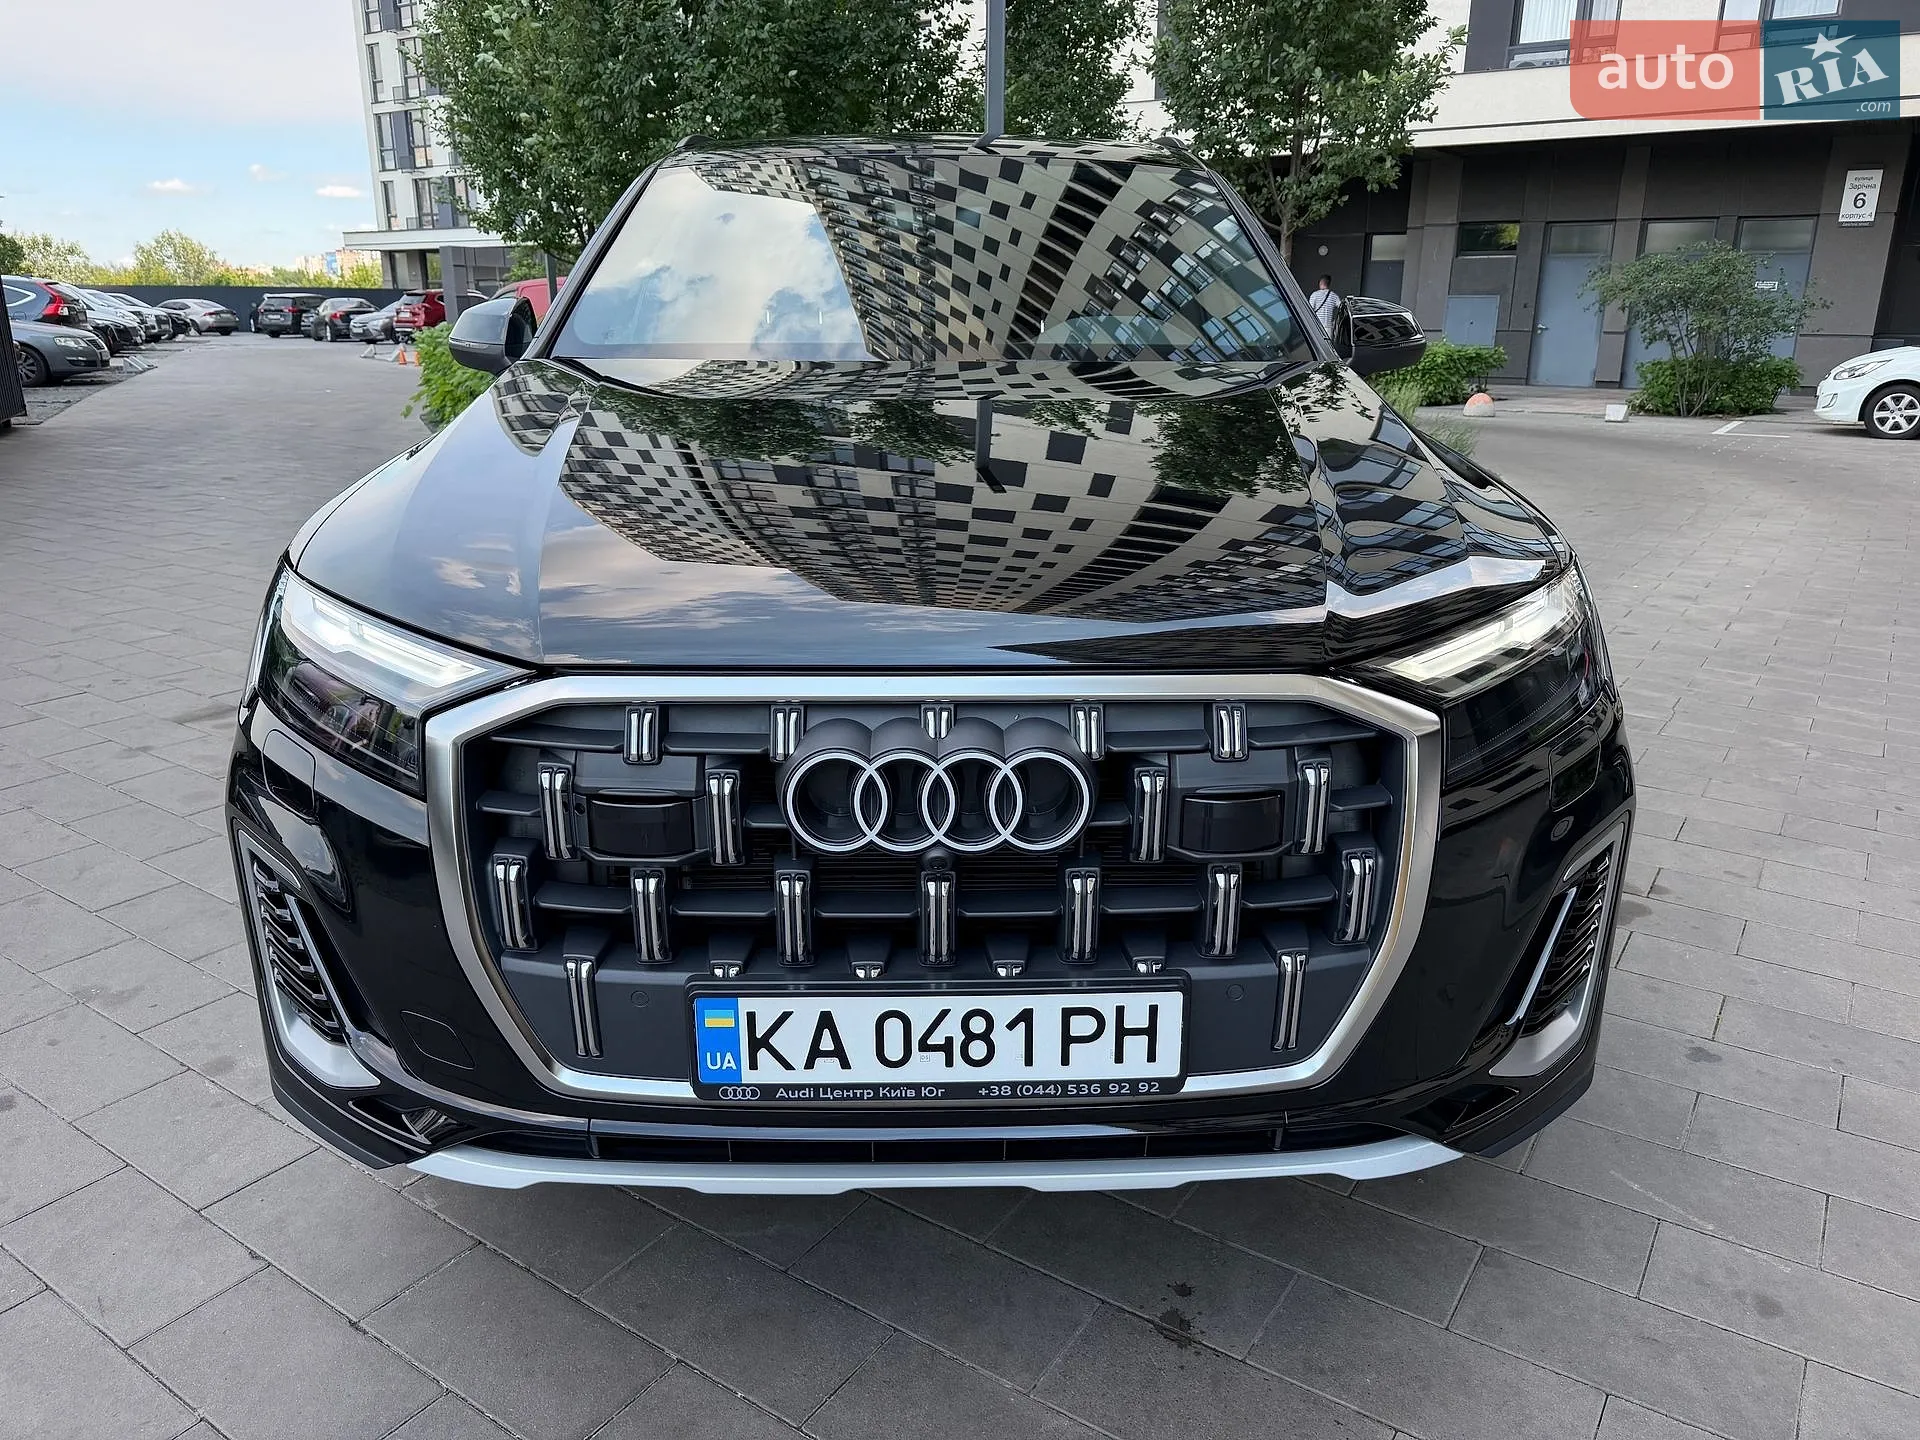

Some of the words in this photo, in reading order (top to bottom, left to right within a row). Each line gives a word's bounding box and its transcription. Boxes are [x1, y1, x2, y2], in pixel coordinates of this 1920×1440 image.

[1848, 182, 1877, 190] Зарічна
[1853, 192, 1867, 209] 6
[746, 1010, 852, 1071] KA
[874, 1008, 1034, 1069] 0481
[706, 1052, 737, 1070] UA
[776, 1087, 814, 1099] Audi
[819, 1087, 874, 1100] Центр
[879, 1085, 916, 1098] Київ
[921, 1086, 946, 1098] Юг
[978, 1085, 1012, 1096] +38
[1016, 1084, 1062, 1096] (044)
[1067, 1083, 1101, 1095] 536
[1108, 1083, 1131, 1094] 92
[1138, 1082, 1160, 1093] 92
